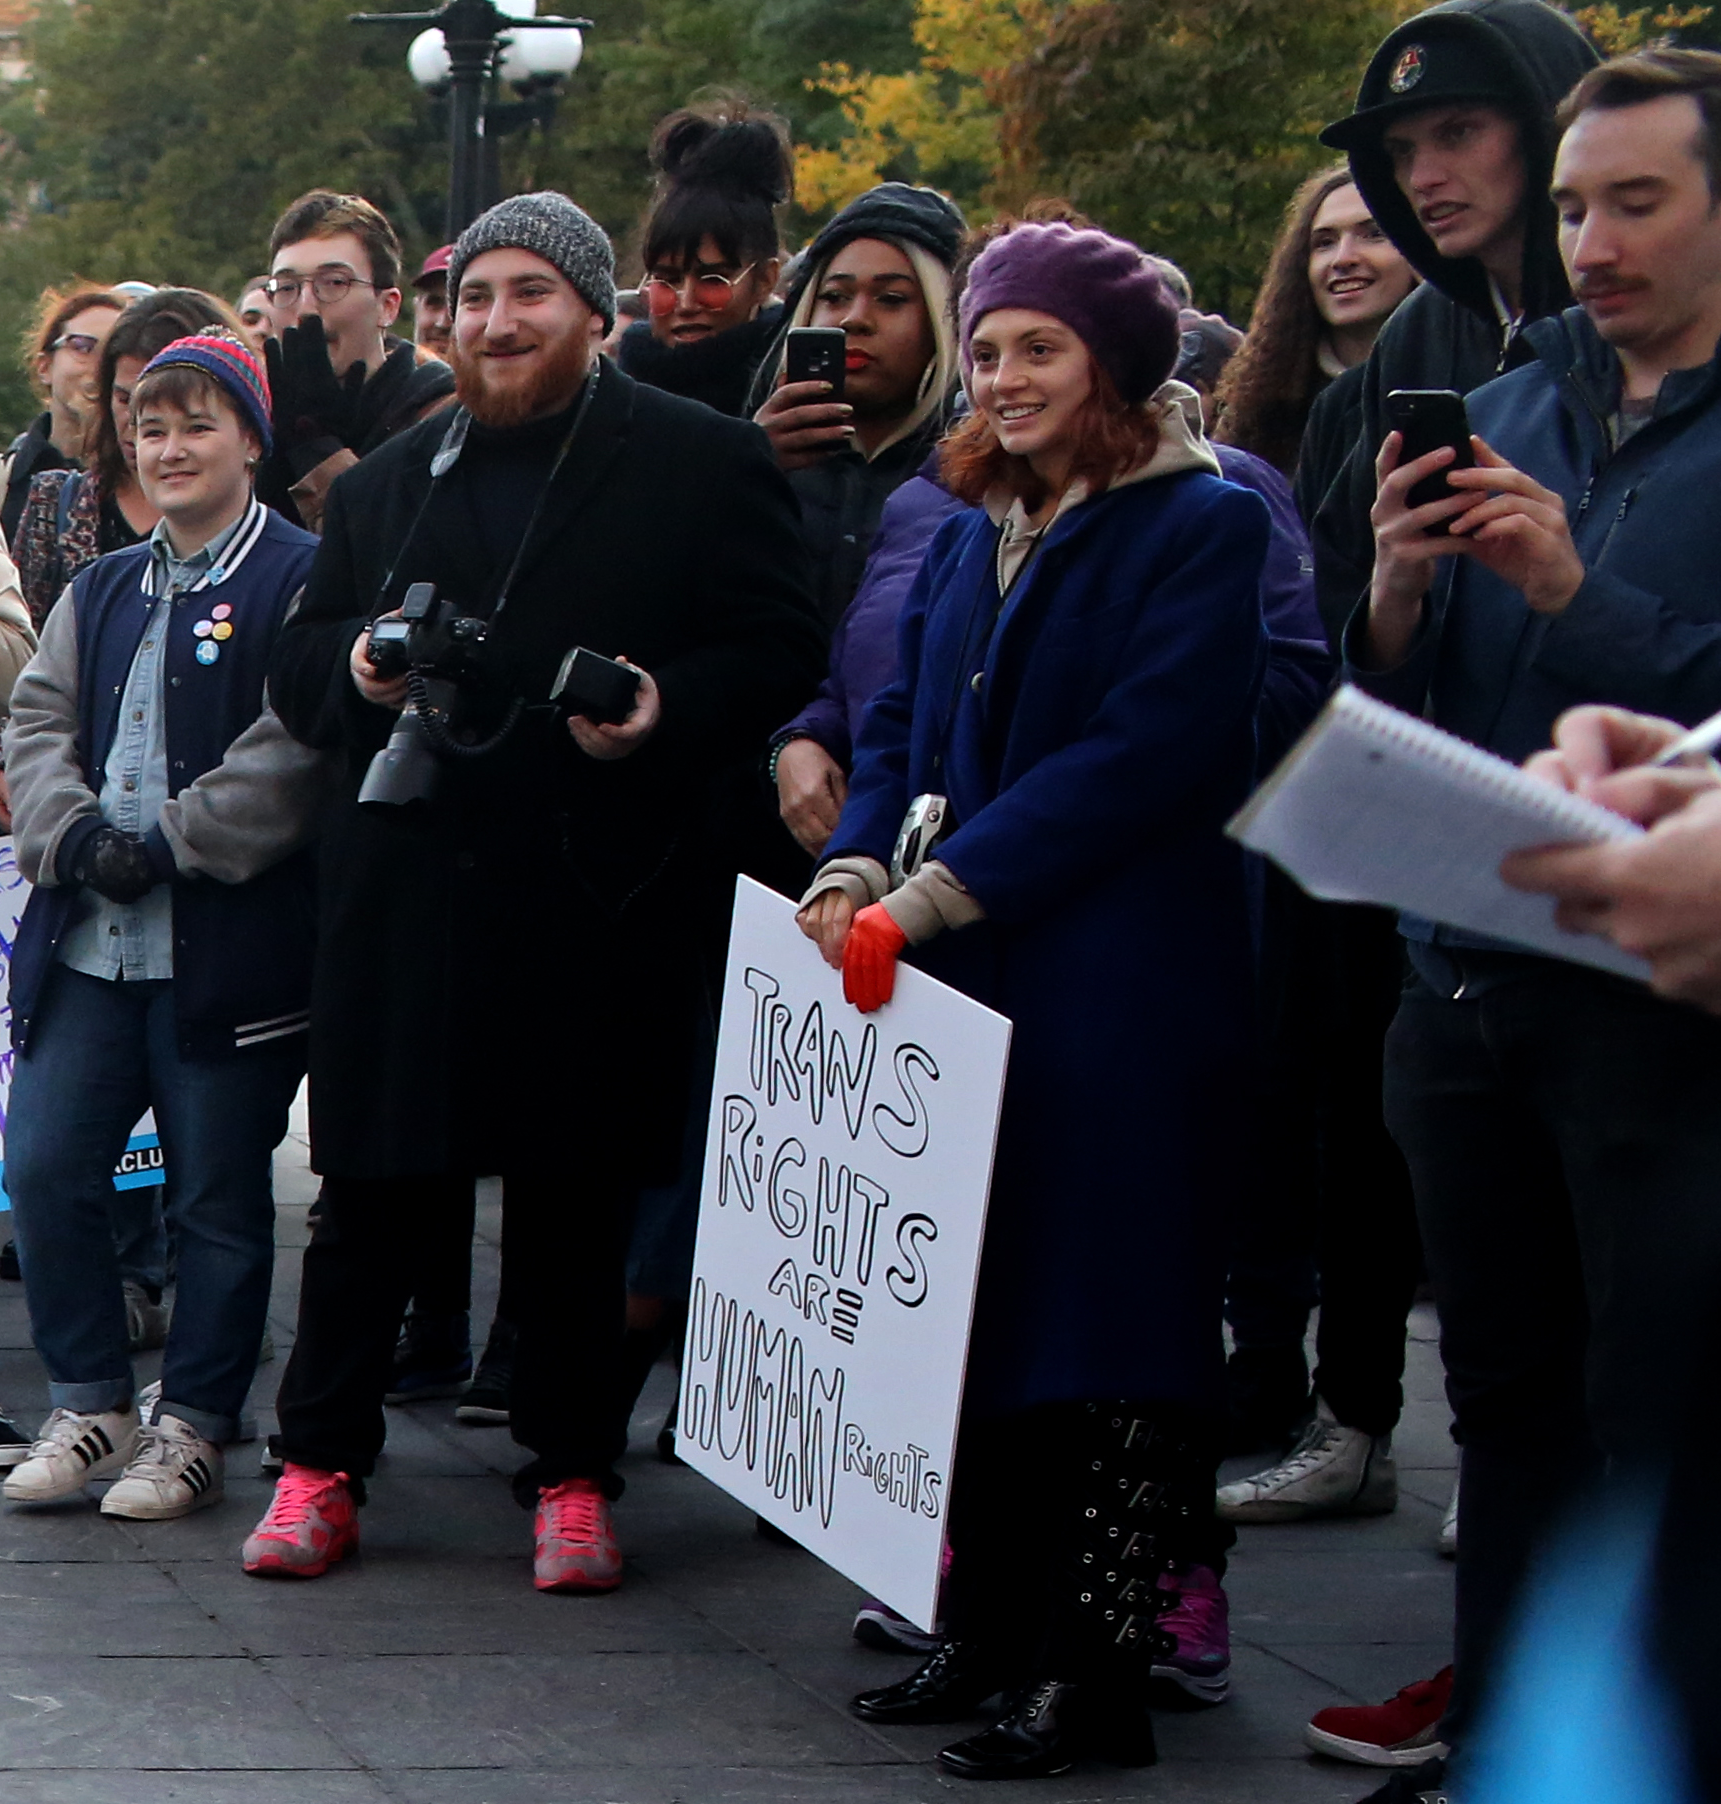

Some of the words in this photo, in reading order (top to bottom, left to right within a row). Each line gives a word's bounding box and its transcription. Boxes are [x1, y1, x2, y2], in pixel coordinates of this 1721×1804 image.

[744, 968, 941, 1158] TRANS
[113, 1147, 165, 1175] CLU
[768, 1257, 864, 1344] ARE
[684, 1276, 845, 1530] HUMAN
